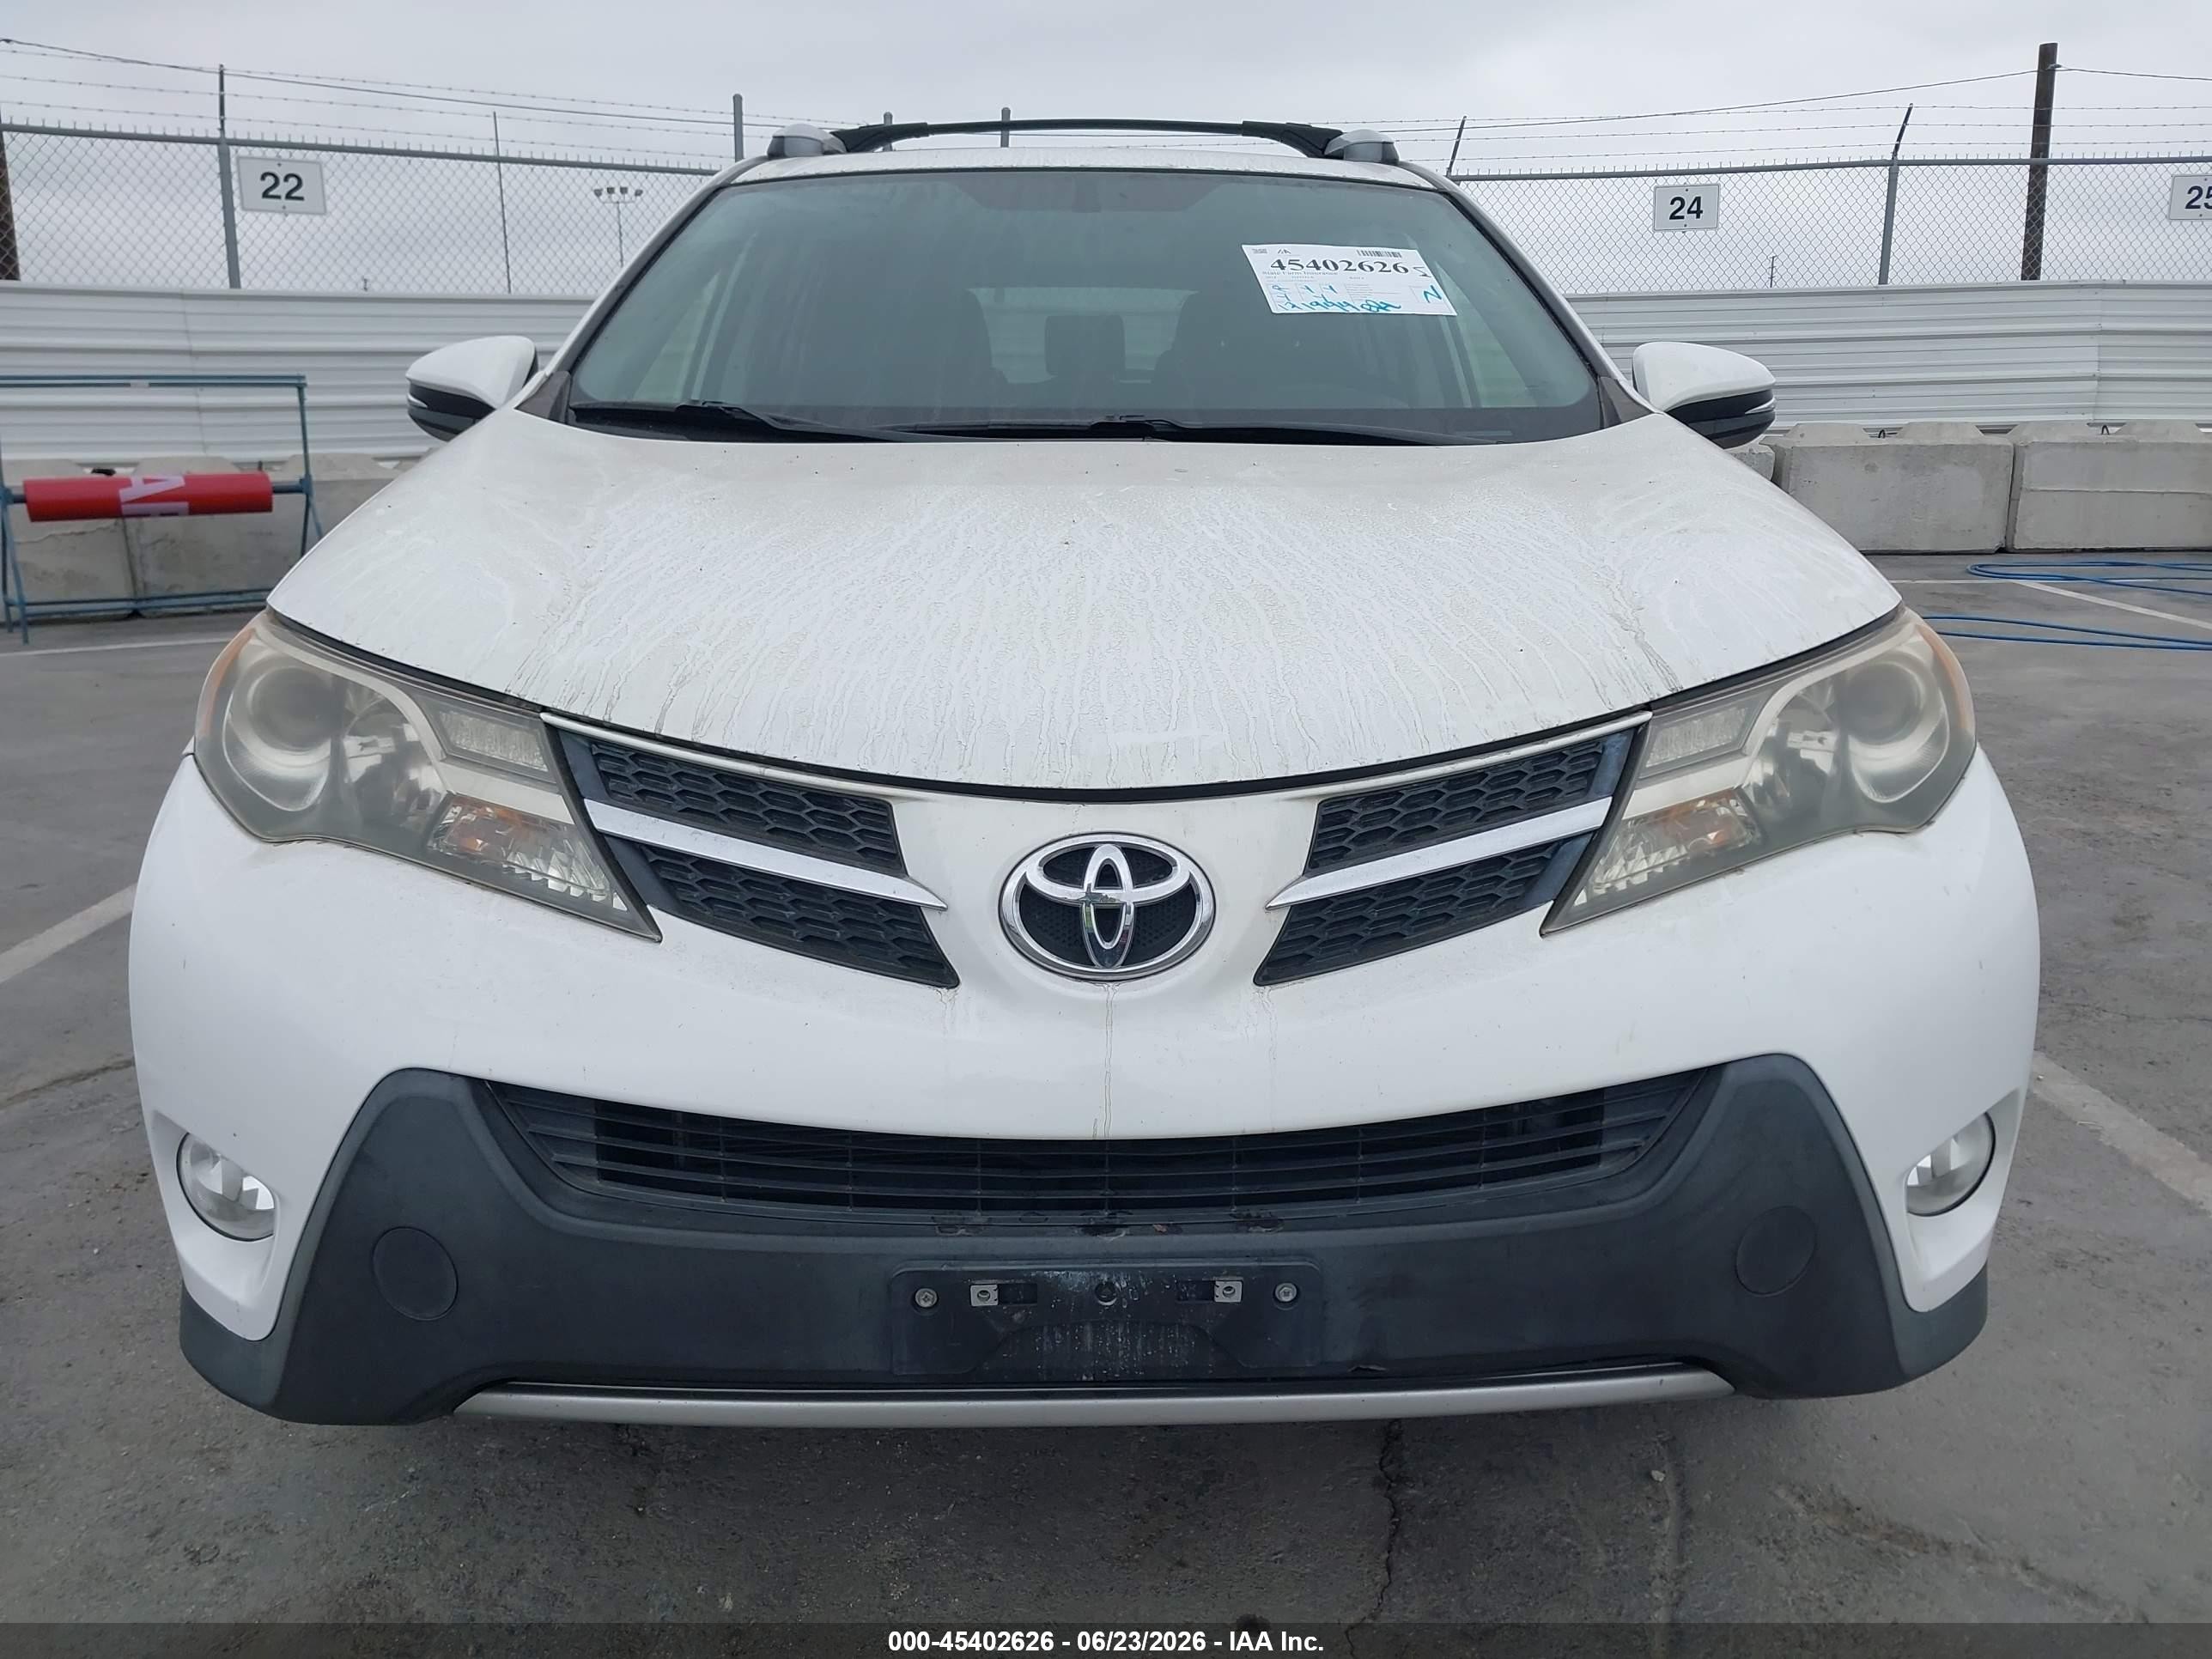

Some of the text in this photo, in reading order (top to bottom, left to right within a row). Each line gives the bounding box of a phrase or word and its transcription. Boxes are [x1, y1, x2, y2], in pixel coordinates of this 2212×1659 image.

[260, 171, 305, 201] 22
[1668, 196, 1704, 220] 24
[1270, 258, 1409, 275] 45402626
